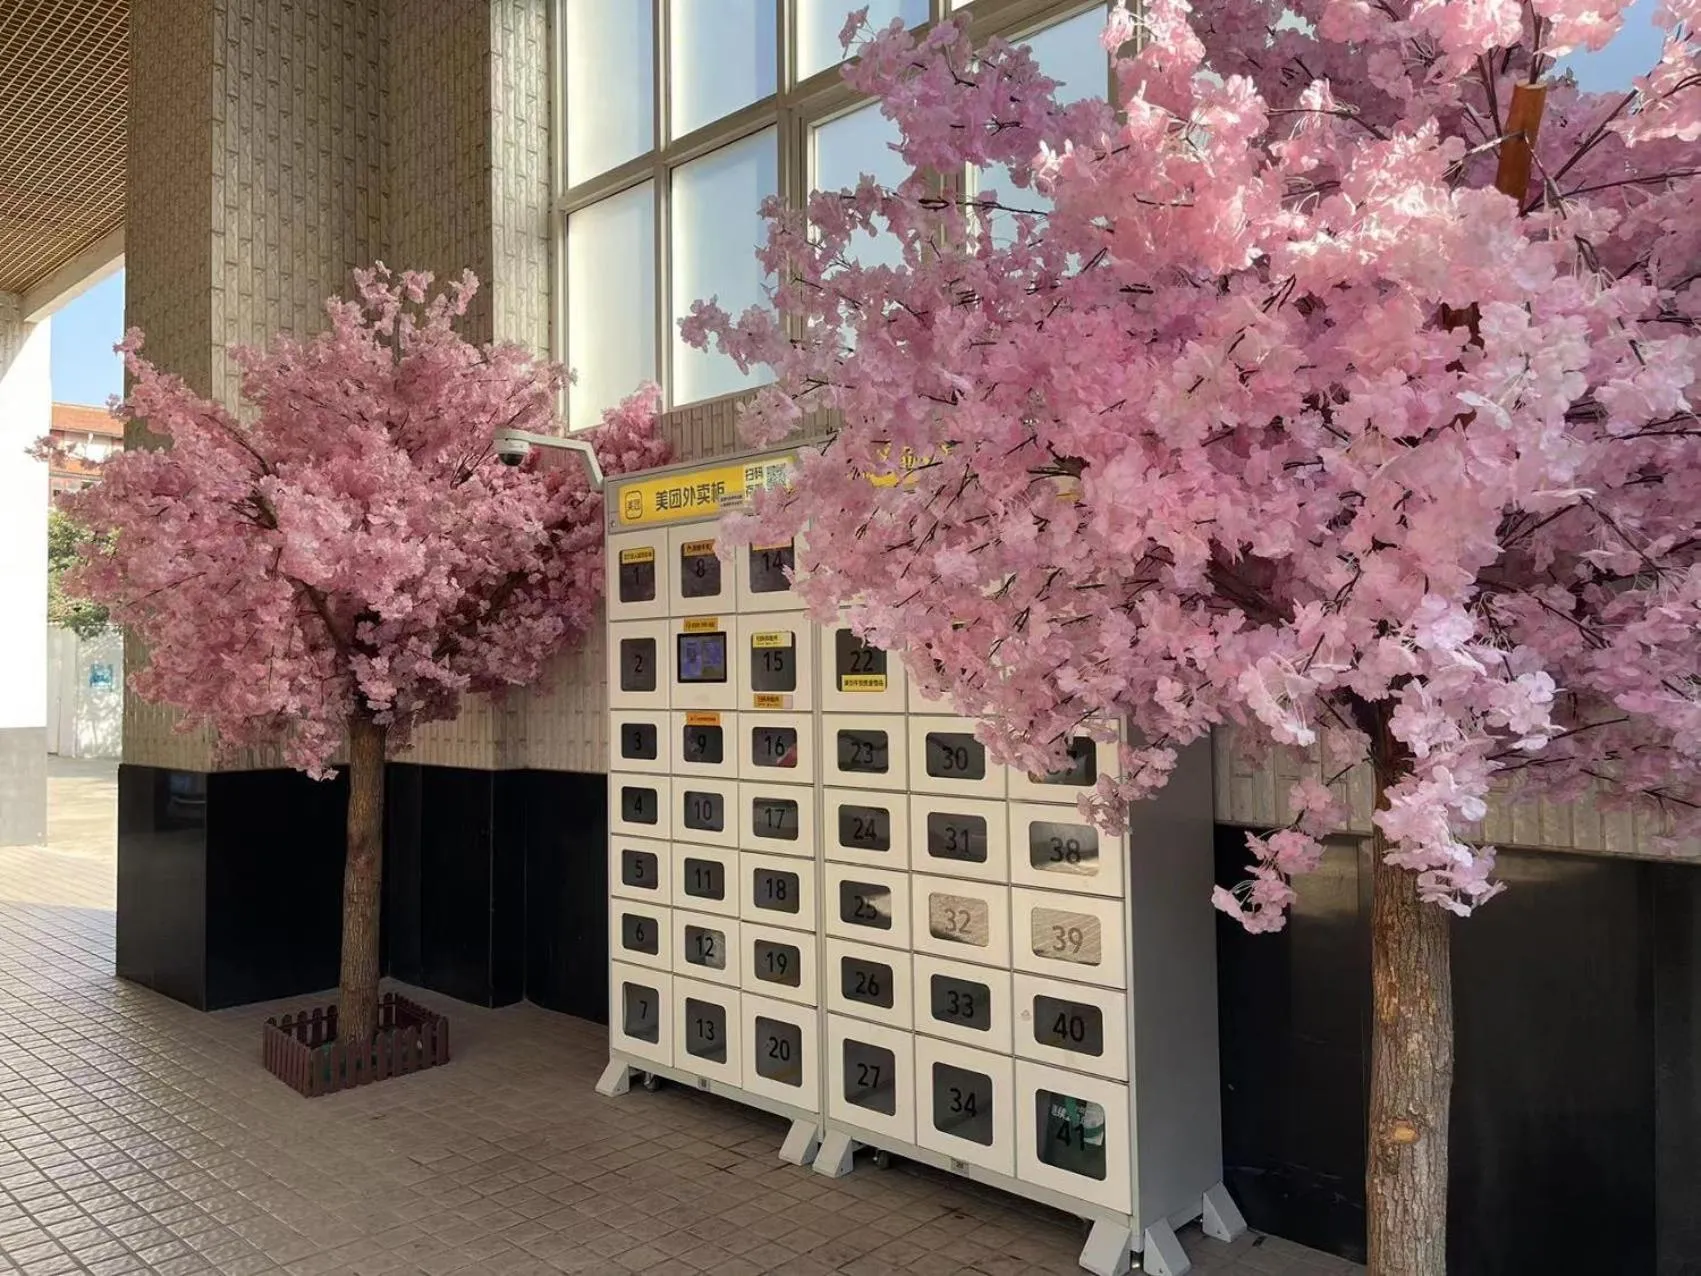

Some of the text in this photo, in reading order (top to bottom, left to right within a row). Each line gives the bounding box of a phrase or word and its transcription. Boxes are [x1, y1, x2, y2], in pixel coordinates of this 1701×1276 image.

[655, 481, 725, 511] 美团外卖柜
[696, 559, 706, 578] 8
[762, 552, 783, 572] 14
[634, 654, 643, 673] 2
[763, 651, 783, 672] 15
[850, 650, 874, 672] 22
[634, 731, 642, 750] 3
[697, 734, 706, 754] 9
[764, 735, 785, 756] 16
[851, 742, 874, 764] 23
[942, 747, 968, 771] 30
[634, 794, 642, 814] 4
[694, 800, 712, 821] 10
[764, 808, 785, 829] 17
[853, 818, 877, 841] 24
[945, 827, 970, 853] 31
[1050, 837, 1080, 864] 38
[635, 860, 643, 879] 5
[695, 868, 712, 890] 11
[766, 878, 786, 900] 18
[853, 895, 878, 920] 25
[944, 908, 972, 933] 32
[635, 923, 644, 942] 6
[1052, 925, 1083, 954] 39
[695, 935, 714, 957] 12
[766, 951, 787, 975] 19
[855, 972, 880, 997] 26
[639, 1000, 648, 1019] 7
[947, 990, 974, 1019] 33
[696, 1019, 715, 1041] 13
[1052, 1012, 1085, 1043] 40
[769, 1036, 790, 1061] 20
[857, 1063, 881, 1088] 27
[949, 1088, 977, 1118] 34
[1056, 1120, 1085, 1151] 41
